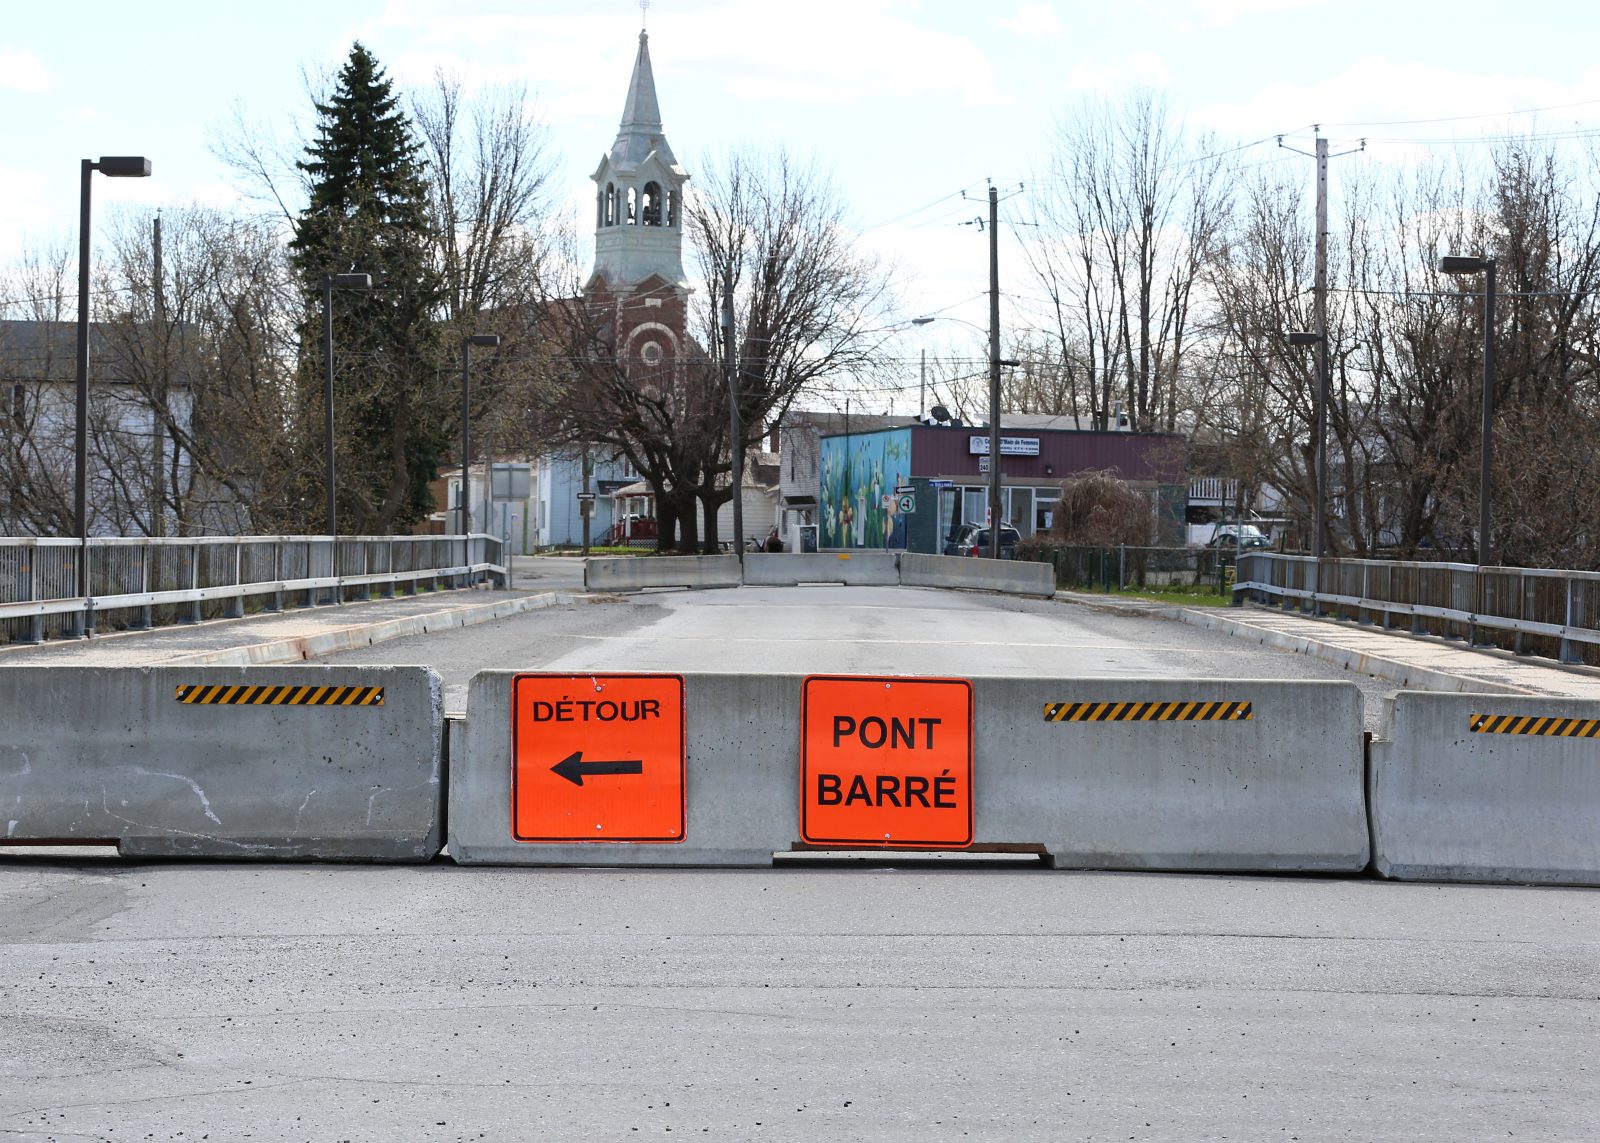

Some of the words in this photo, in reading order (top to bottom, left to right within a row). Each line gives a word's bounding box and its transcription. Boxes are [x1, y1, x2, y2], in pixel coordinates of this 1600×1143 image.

[533, 696, 660, 722] DÉTOUR
[833, 715, 942, 750] PONT
[817, 769, 957, 809] BARRÉ
